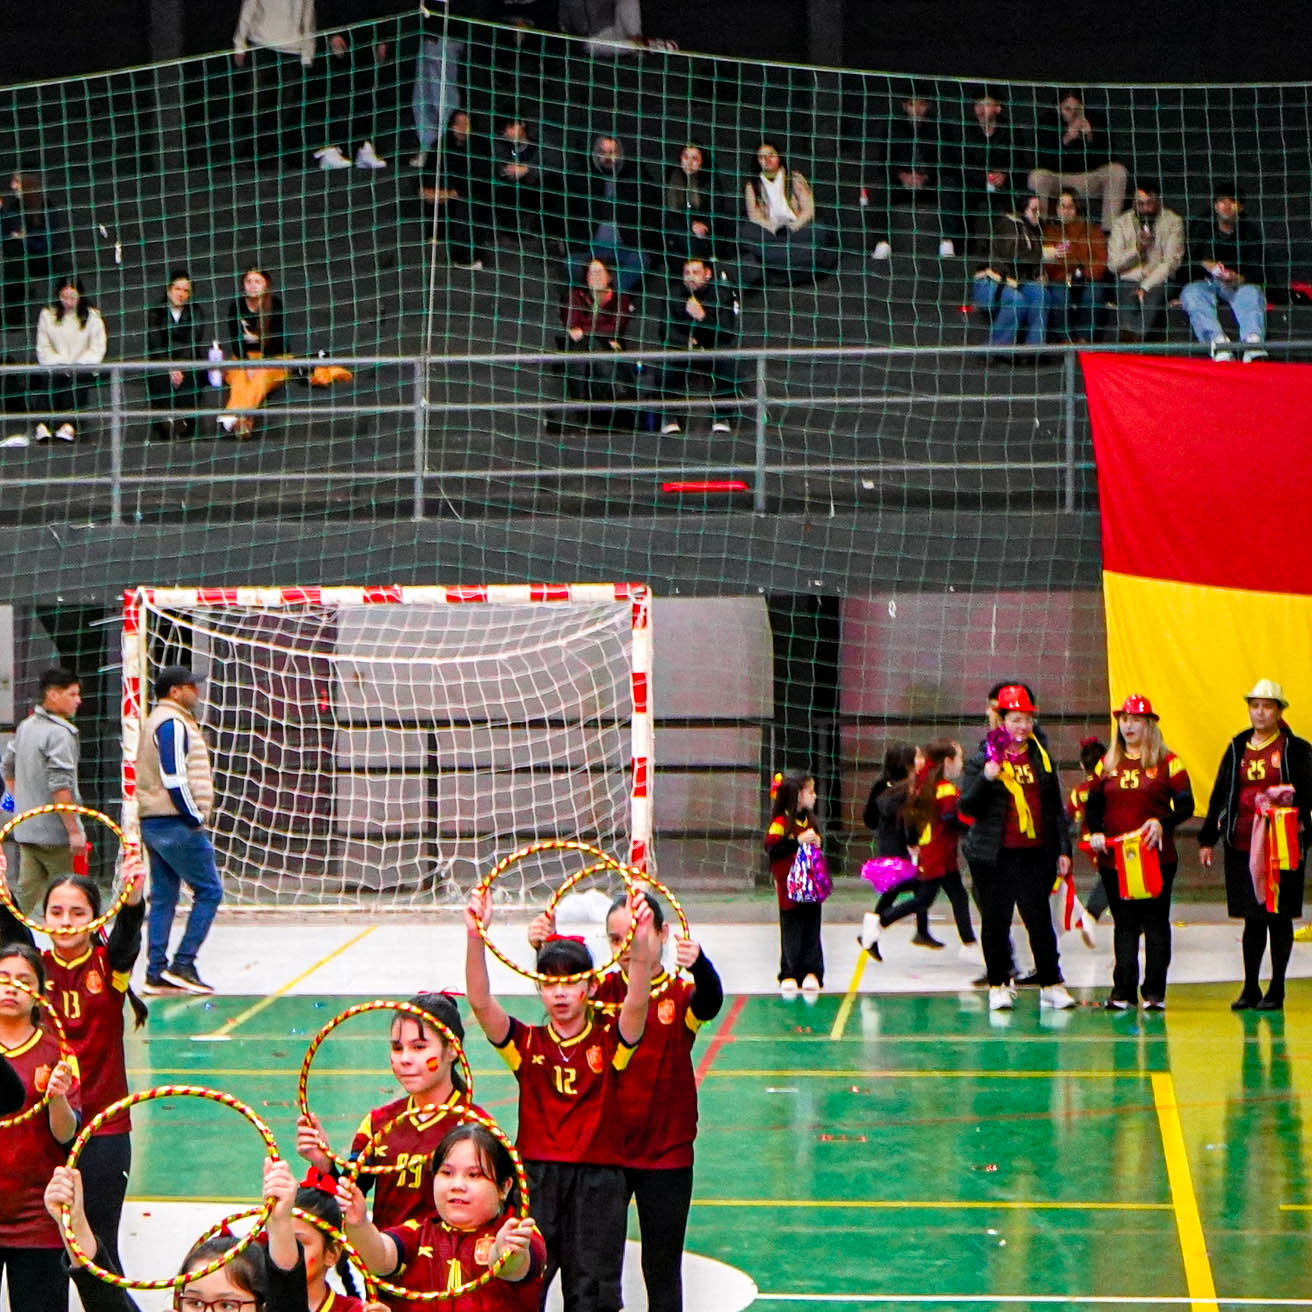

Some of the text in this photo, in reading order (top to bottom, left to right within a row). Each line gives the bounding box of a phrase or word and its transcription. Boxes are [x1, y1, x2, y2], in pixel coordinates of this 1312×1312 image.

[1015, 764, 1034, 785] 25
[1119, 769, 1140, 789] 25
[1247, 759, 1266, 781] 25
[61, 990, 81, 1018] 13
[553, 1065, 578, 1094] 12
